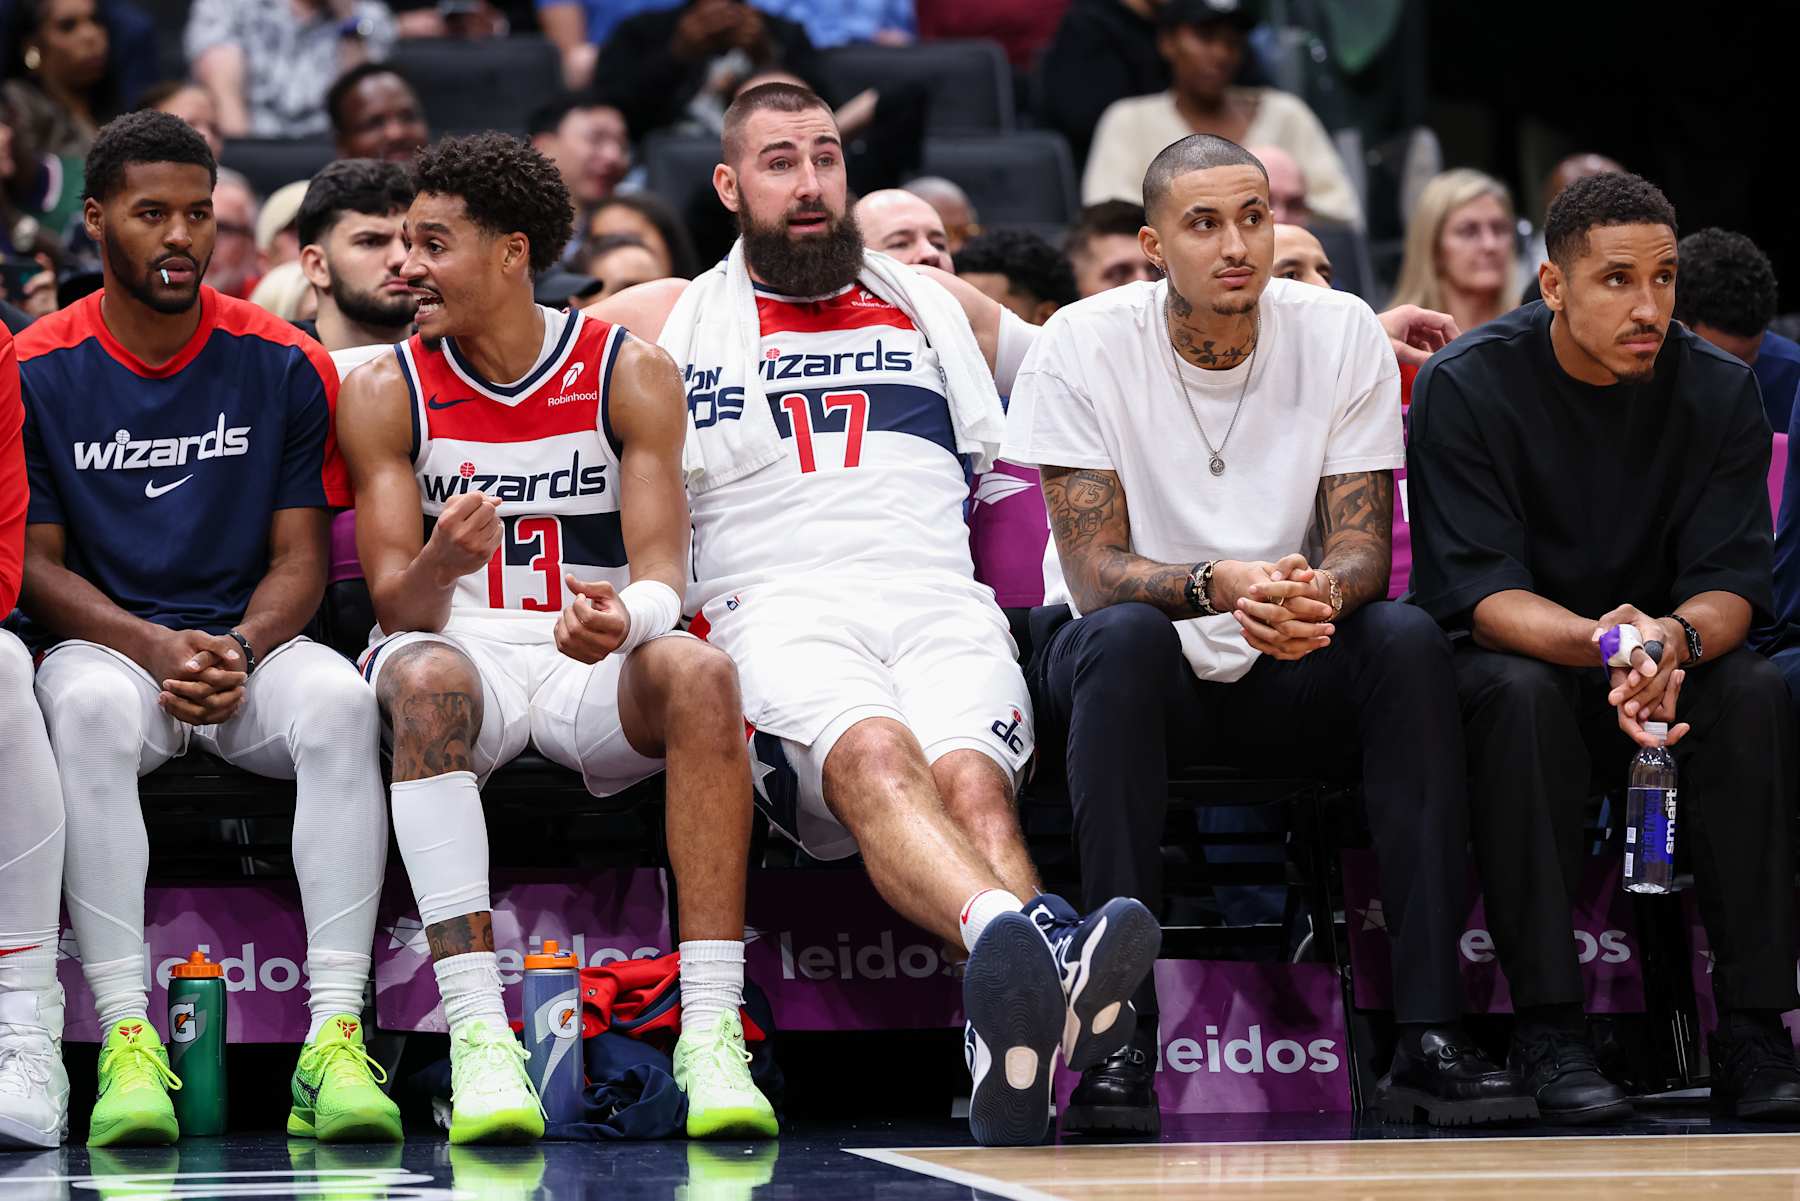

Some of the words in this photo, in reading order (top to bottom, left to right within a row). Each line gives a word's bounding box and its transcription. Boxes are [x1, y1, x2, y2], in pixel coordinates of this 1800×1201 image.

[547, 390, 598, 407] Robinhood
[74, 412, 252, 470] wizards
[780, 390, 870, 474] 17
[424, 449, 608, 502] wizards
[487, 514, 563, 613] 13
[169, 1002, 198, 1044] G
